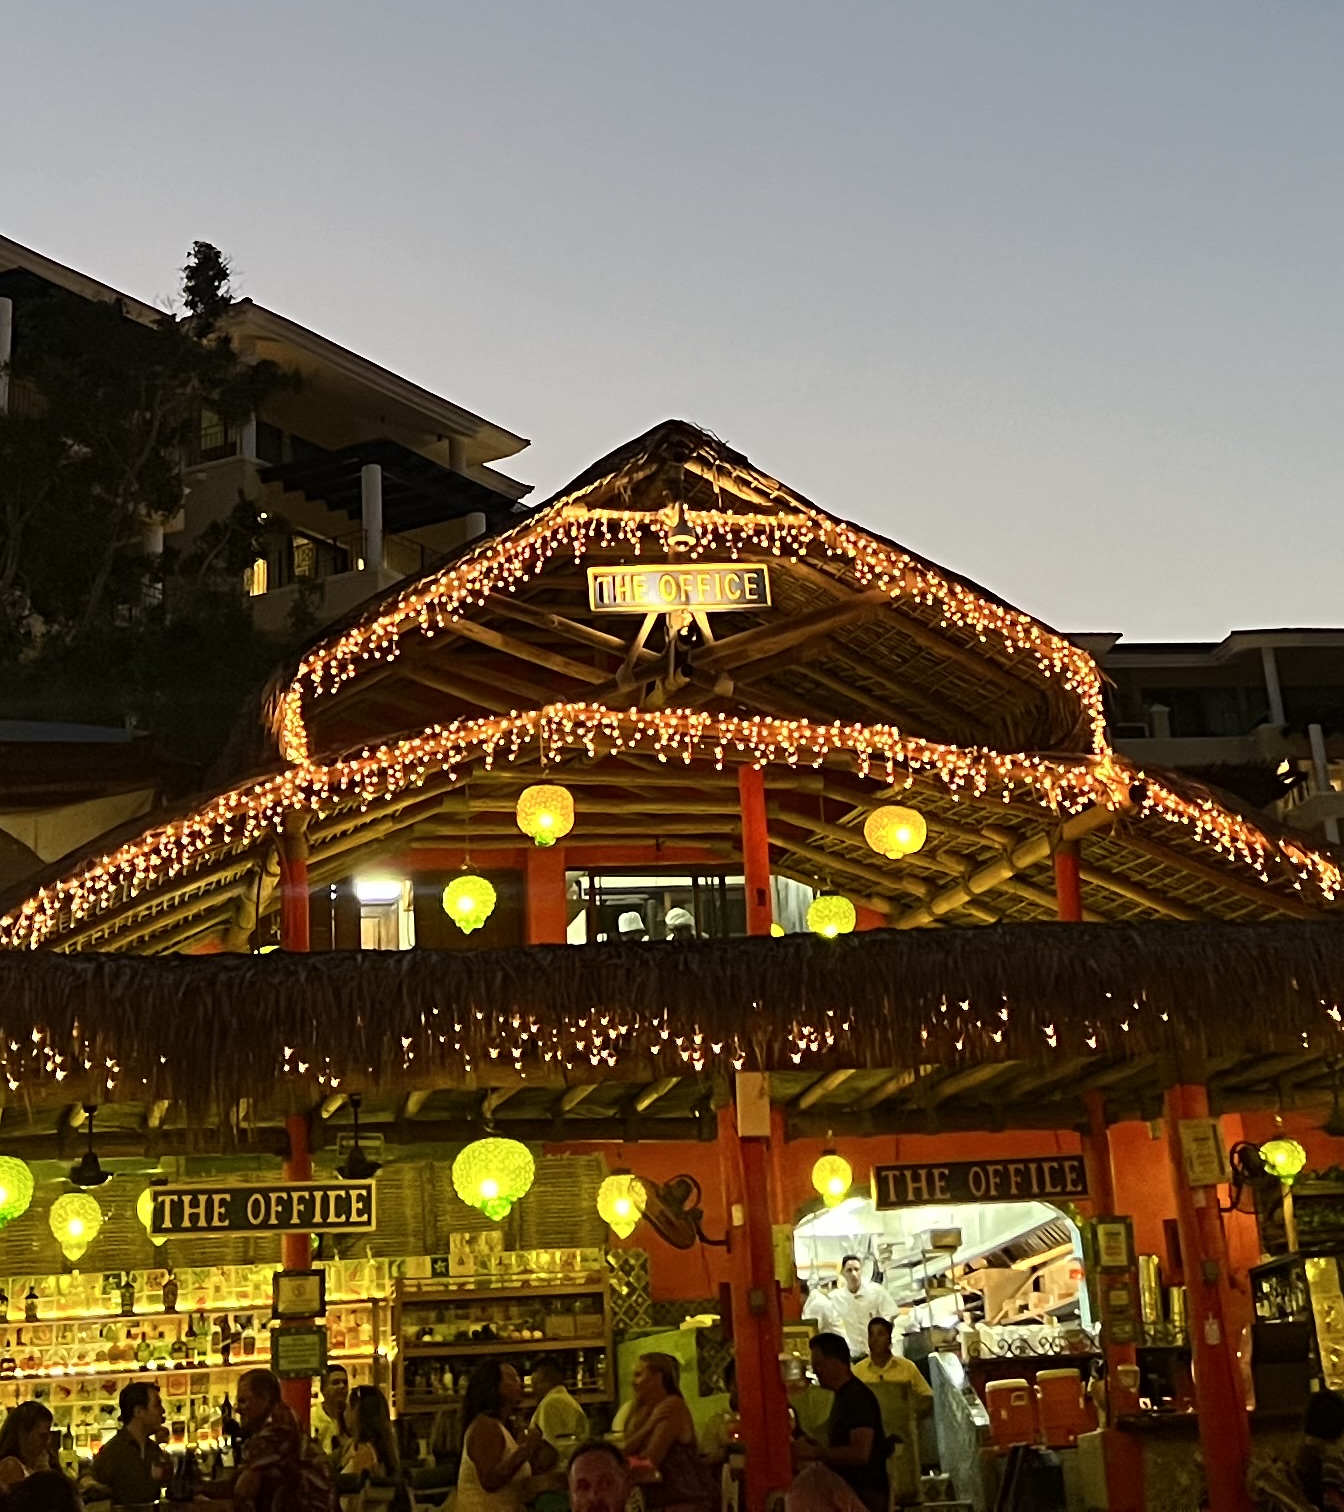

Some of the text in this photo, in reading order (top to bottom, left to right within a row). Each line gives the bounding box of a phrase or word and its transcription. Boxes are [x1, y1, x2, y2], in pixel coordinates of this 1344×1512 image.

[596, 572, 759, 604] THE OFFICE
[881, 1160, 1083, 1202] THE OFFICE
[157, 1189, 369, 1228] THE OFFICE
